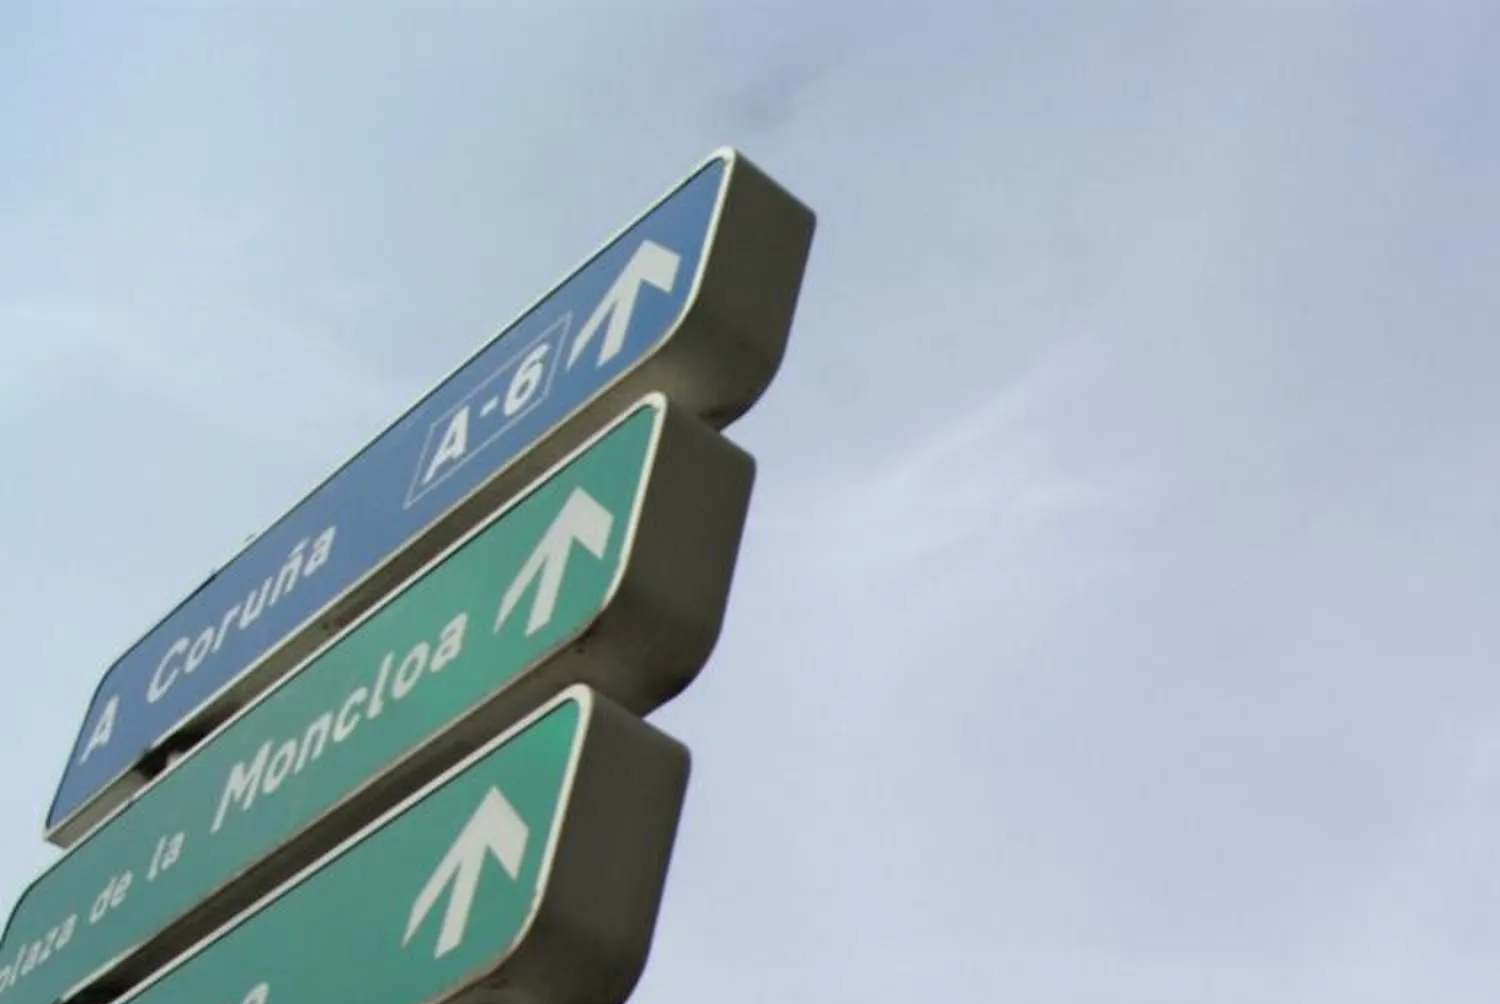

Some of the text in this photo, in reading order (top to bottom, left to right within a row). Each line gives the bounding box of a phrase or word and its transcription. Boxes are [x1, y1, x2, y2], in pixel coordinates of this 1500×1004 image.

[81, 345, 550, 763] A Coruña A-6
[89, 871, 133, 925] de
[147, 831, 184, 880] la
[211, 611, 468, 833] Moncloa
